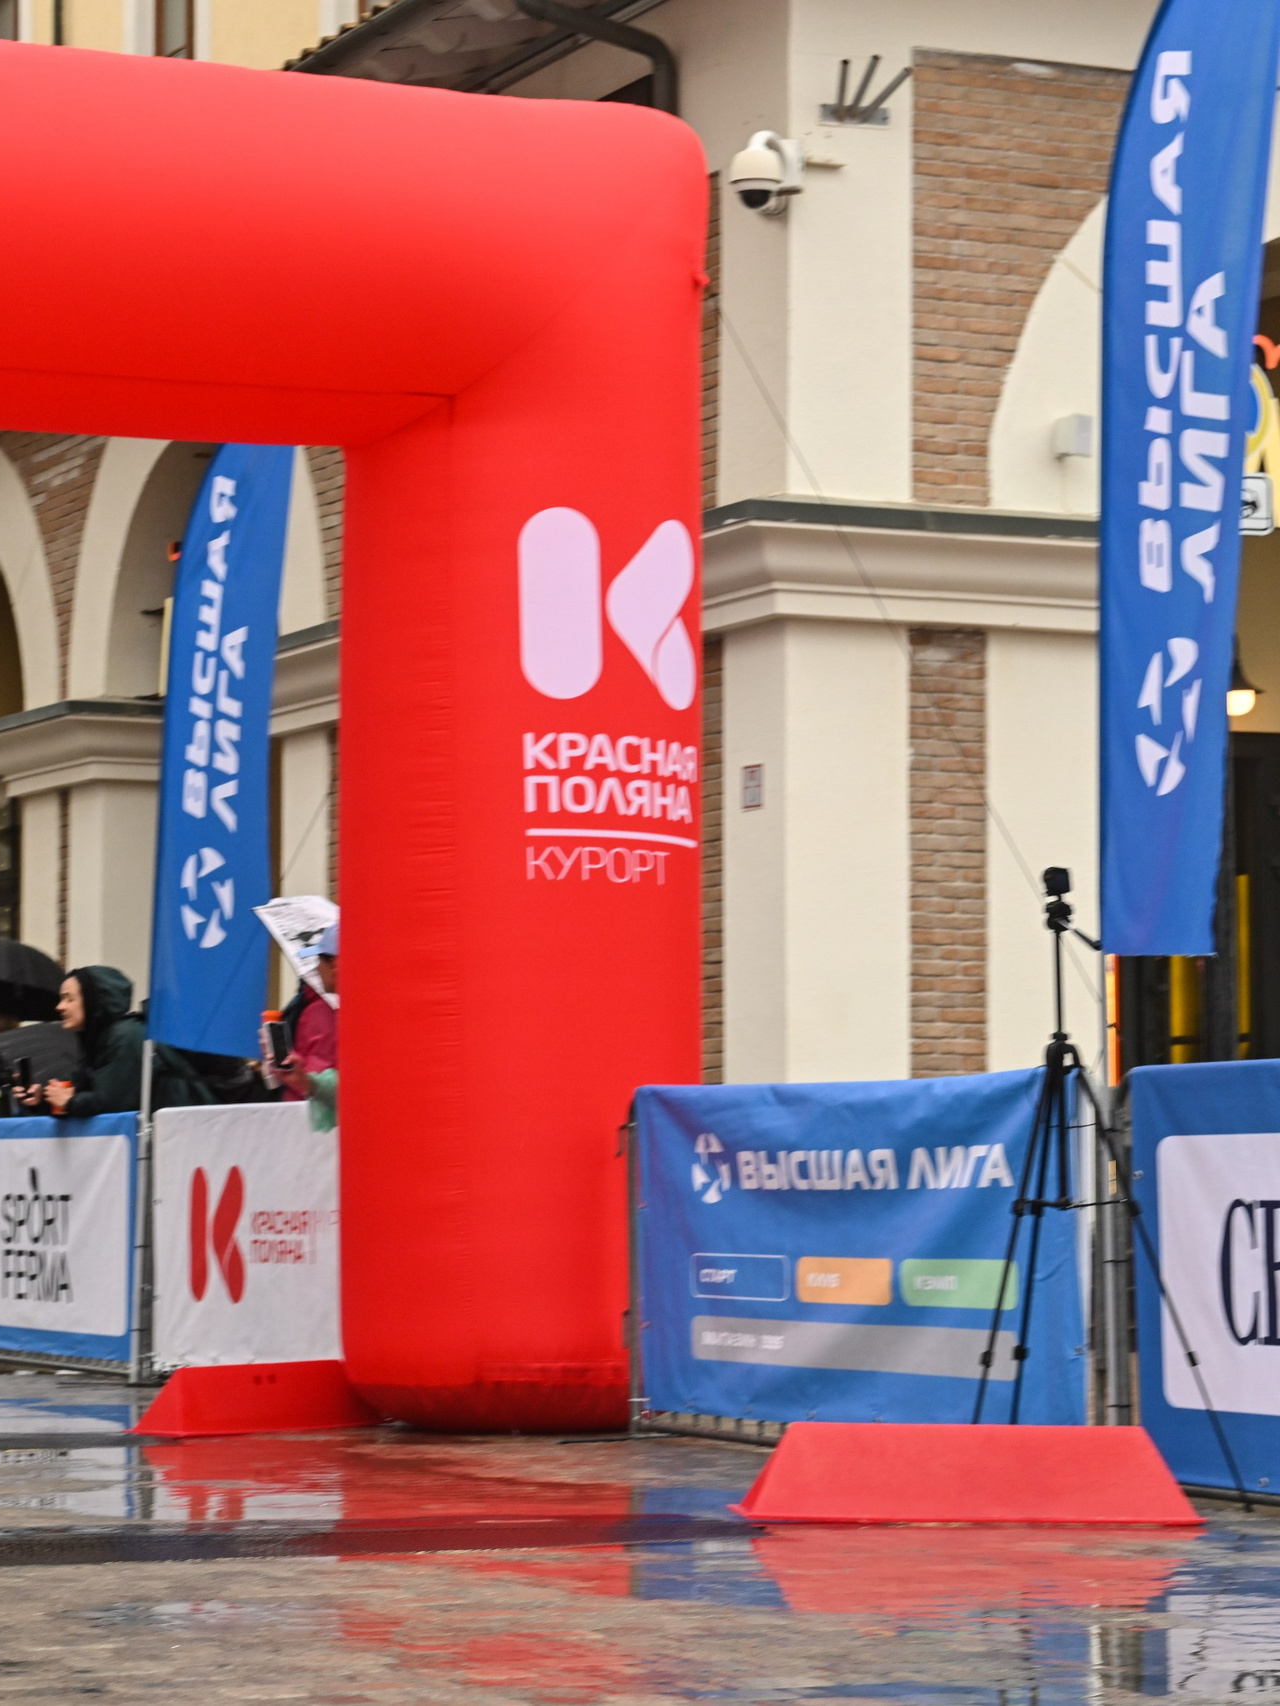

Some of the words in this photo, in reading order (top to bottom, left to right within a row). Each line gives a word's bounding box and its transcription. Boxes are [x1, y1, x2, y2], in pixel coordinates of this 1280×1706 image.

[1139, 49, 1193, 593] ВЫСШАЯ
[1179, 271, 1231, 603] ЛИГА
[182, 474, 238, 820] ВЫСШАЯ
[209, 625, 250, 833] ЛИГА
[522, 731, 698, 783] КРАСНАЯ
[524, 774, 694, 824] ПОЛЯНА
[526, 845, 671, 886] КУРОРТ
[736, 1148, 899, 1190] ВЫСШАЯ
[907, 1143, 1015, 1190] ЛИГА
[0, 1193, 71, 1245] SPORT
[0, 1249, 74, 1303] FERMA
